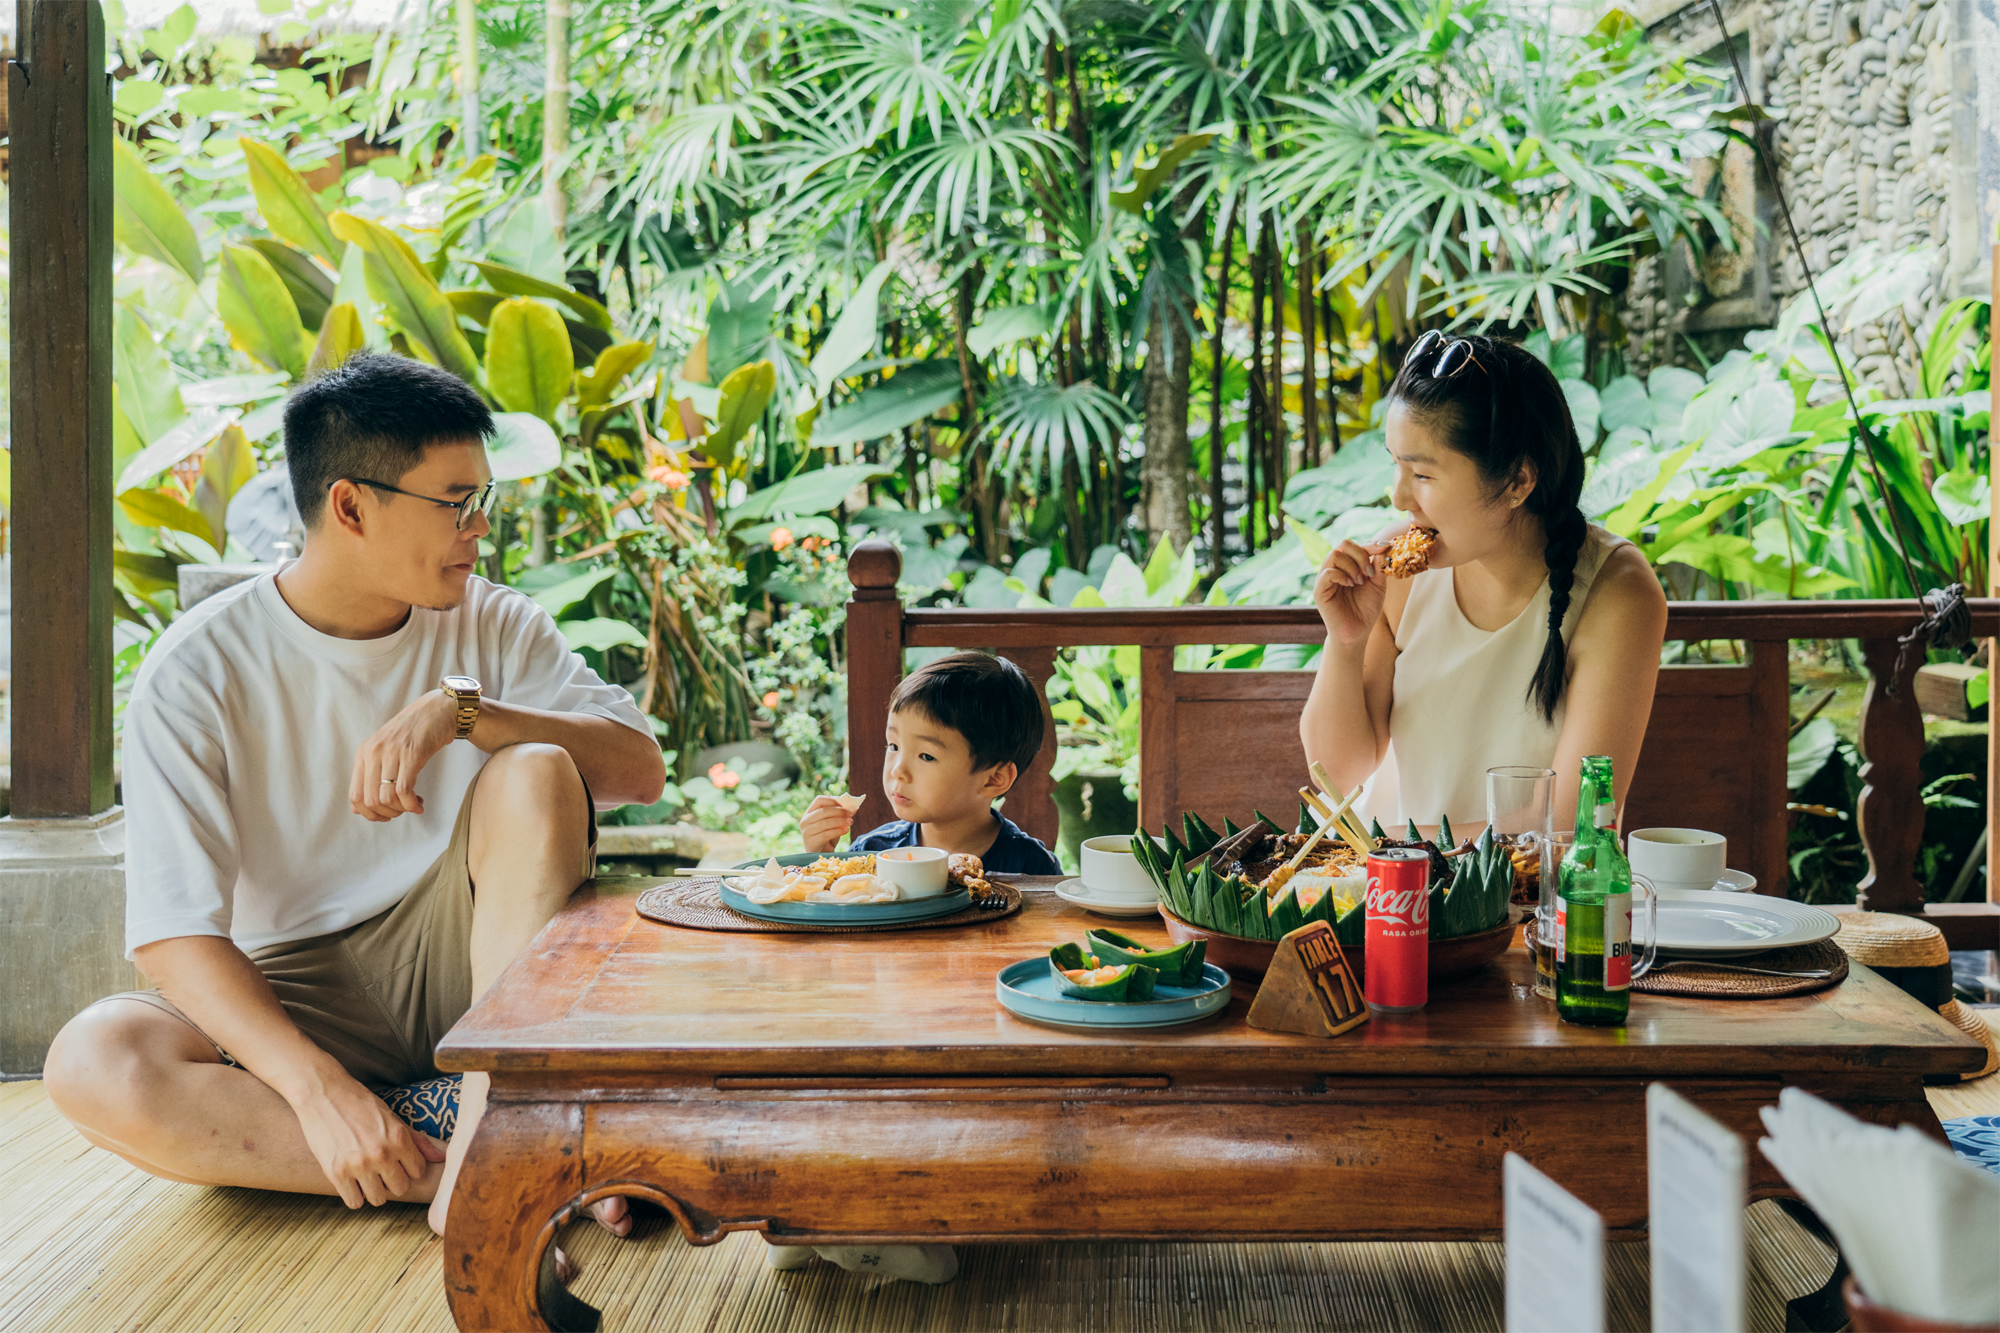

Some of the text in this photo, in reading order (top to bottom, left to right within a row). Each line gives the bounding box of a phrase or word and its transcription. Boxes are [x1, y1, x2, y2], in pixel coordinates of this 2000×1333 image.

[1366, 867, 1429, 924] Coca-C
[1298, 933, 1339, 970] TABLE
[1382, 929, 1407, 937] RASA
[1612, 940, 1632, 958] BIN
[1317, 963, 1356, 1020] 17
